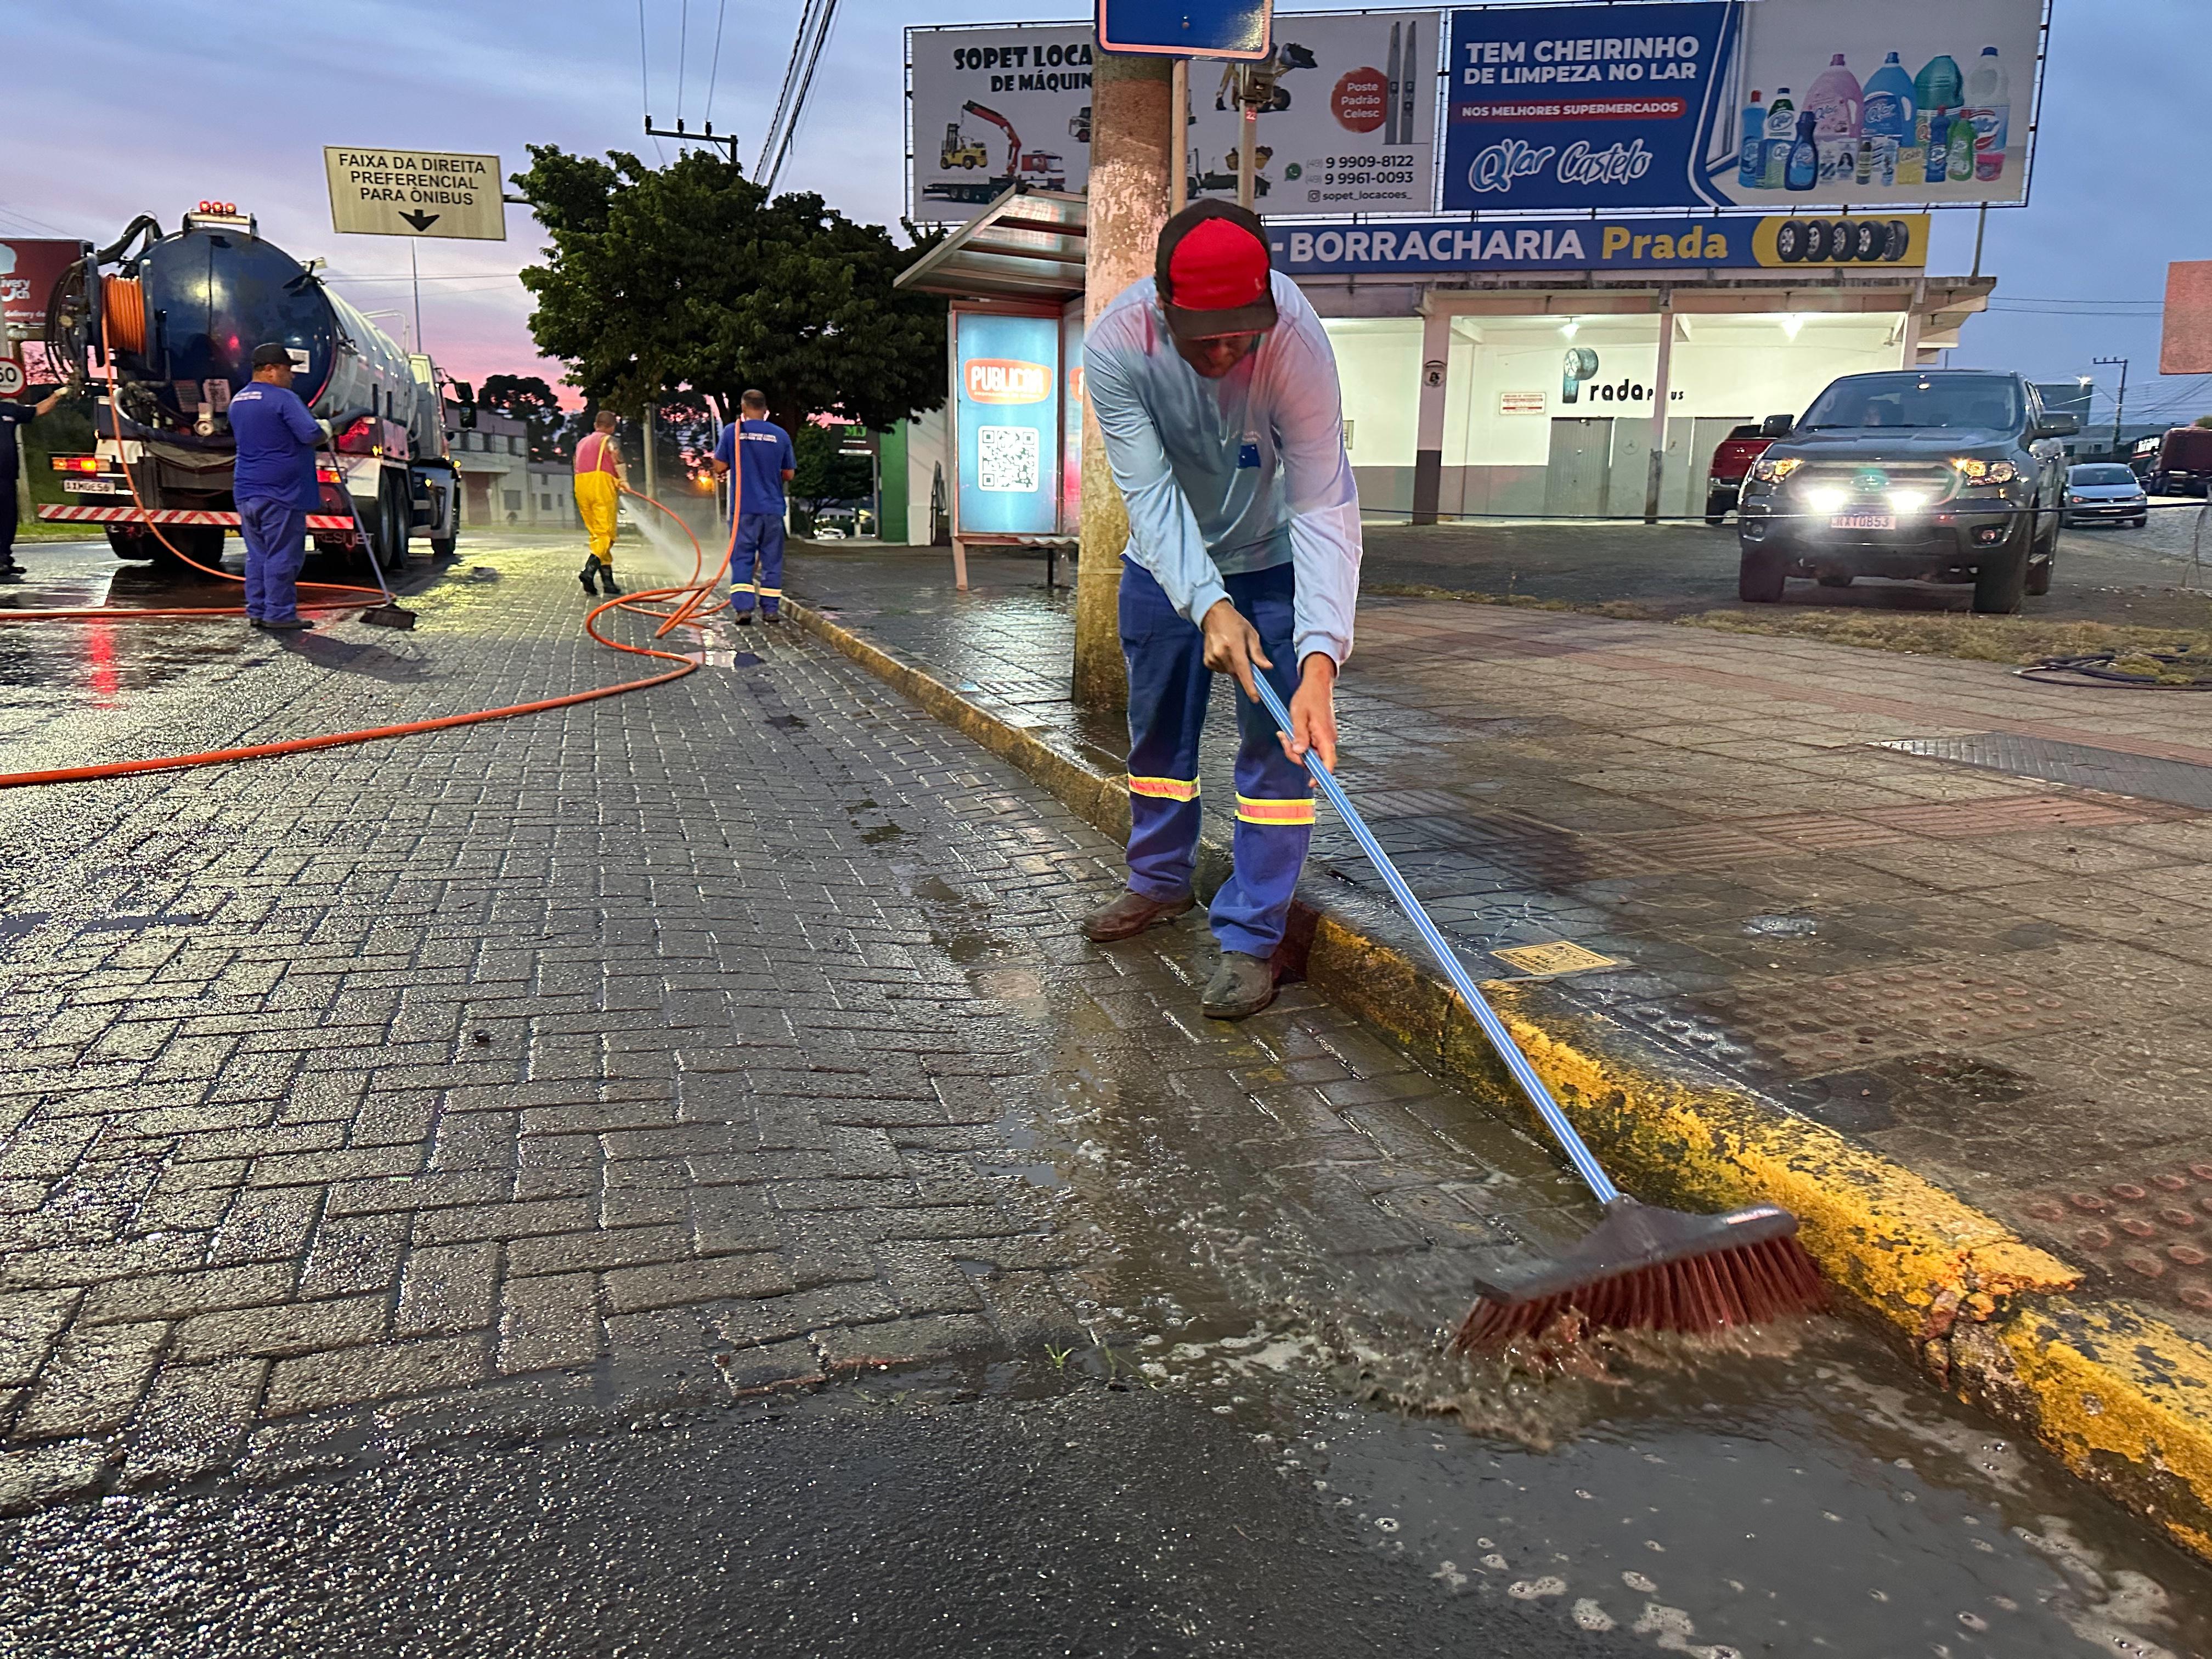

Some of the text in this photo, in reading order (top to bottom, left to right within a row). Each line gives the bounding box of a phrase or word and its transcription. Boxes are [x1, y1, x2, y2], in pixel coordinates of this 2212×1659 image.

[953, 44, 1093, 70] SOPET LOCA
[1465, 36, 1699, 63] TEM CHEIRINHO
[991, 70, 1092, 93] DE MÁQUIN
[1464, 63, 1696, 84] DE LIMPEZA NO LAR
[1347, 83, 1378, 92] Poste
[1341, 95, 1380, 105] Padrão
[1462, 102, 1678, 116] NOS MELHORES SUPERMERCADOS
[1344, 109, 1380, 119] Celesc
[340, 154, 486, 173] FAIXA DA DIREITA
[1325, 157, 1335, 168] 9
[1339, 155, 1414, 168] 9909-8122
[1557, 138, 1652, 185] Castelo
[351, 171, 478, 189] PREFERENCIAL
[1324, 173, 1334, 184] 9
[1338, 172, 1413, 184] 9961-0093
[361, 187, 473, 205] PARA ÔNIBUS
[1323, 191, 1413, 201] sopet_locacoes_
[1290, 229, 1585, 262] BORRACHARIA
[1602, 225, 1728, 259] Prada
[1647, 388, 1684, 400] pus
